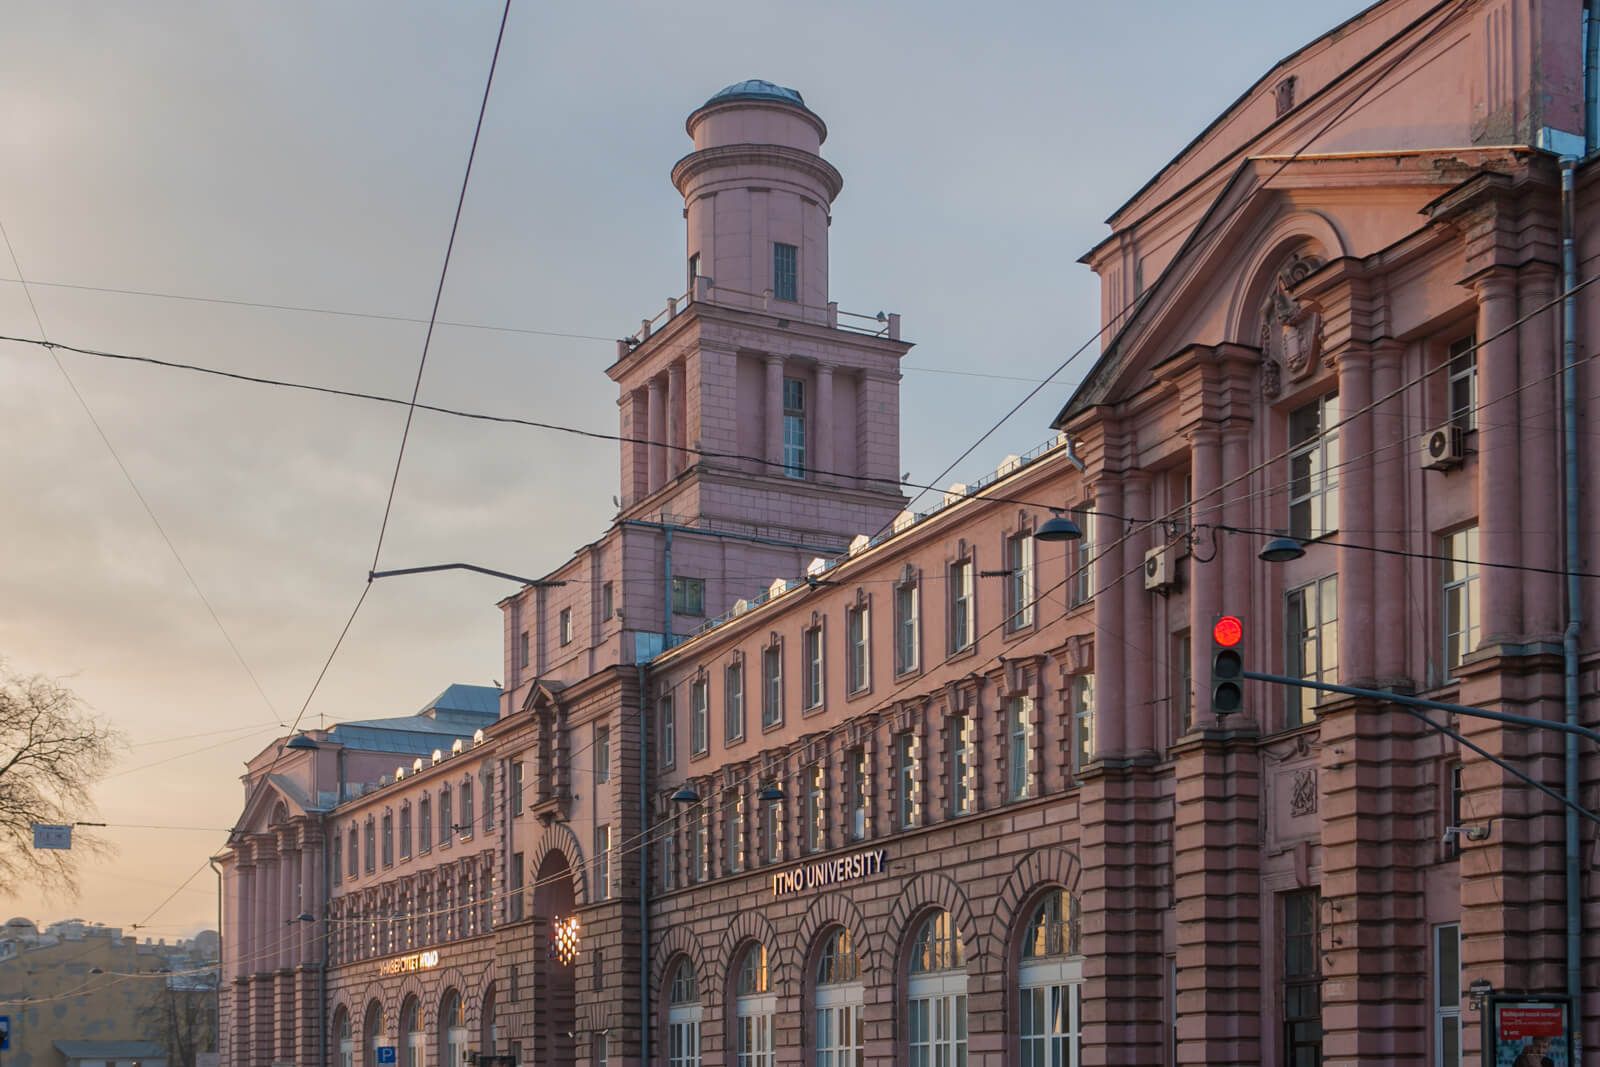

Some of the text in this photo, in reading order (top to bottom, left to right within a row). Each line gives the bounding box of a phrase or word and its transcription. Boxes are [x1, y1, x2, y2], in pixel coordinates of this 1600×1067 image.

[773, 850, 884, 896] ITMO UNIVERSITY
[382, 1048, 393, 1062] P
